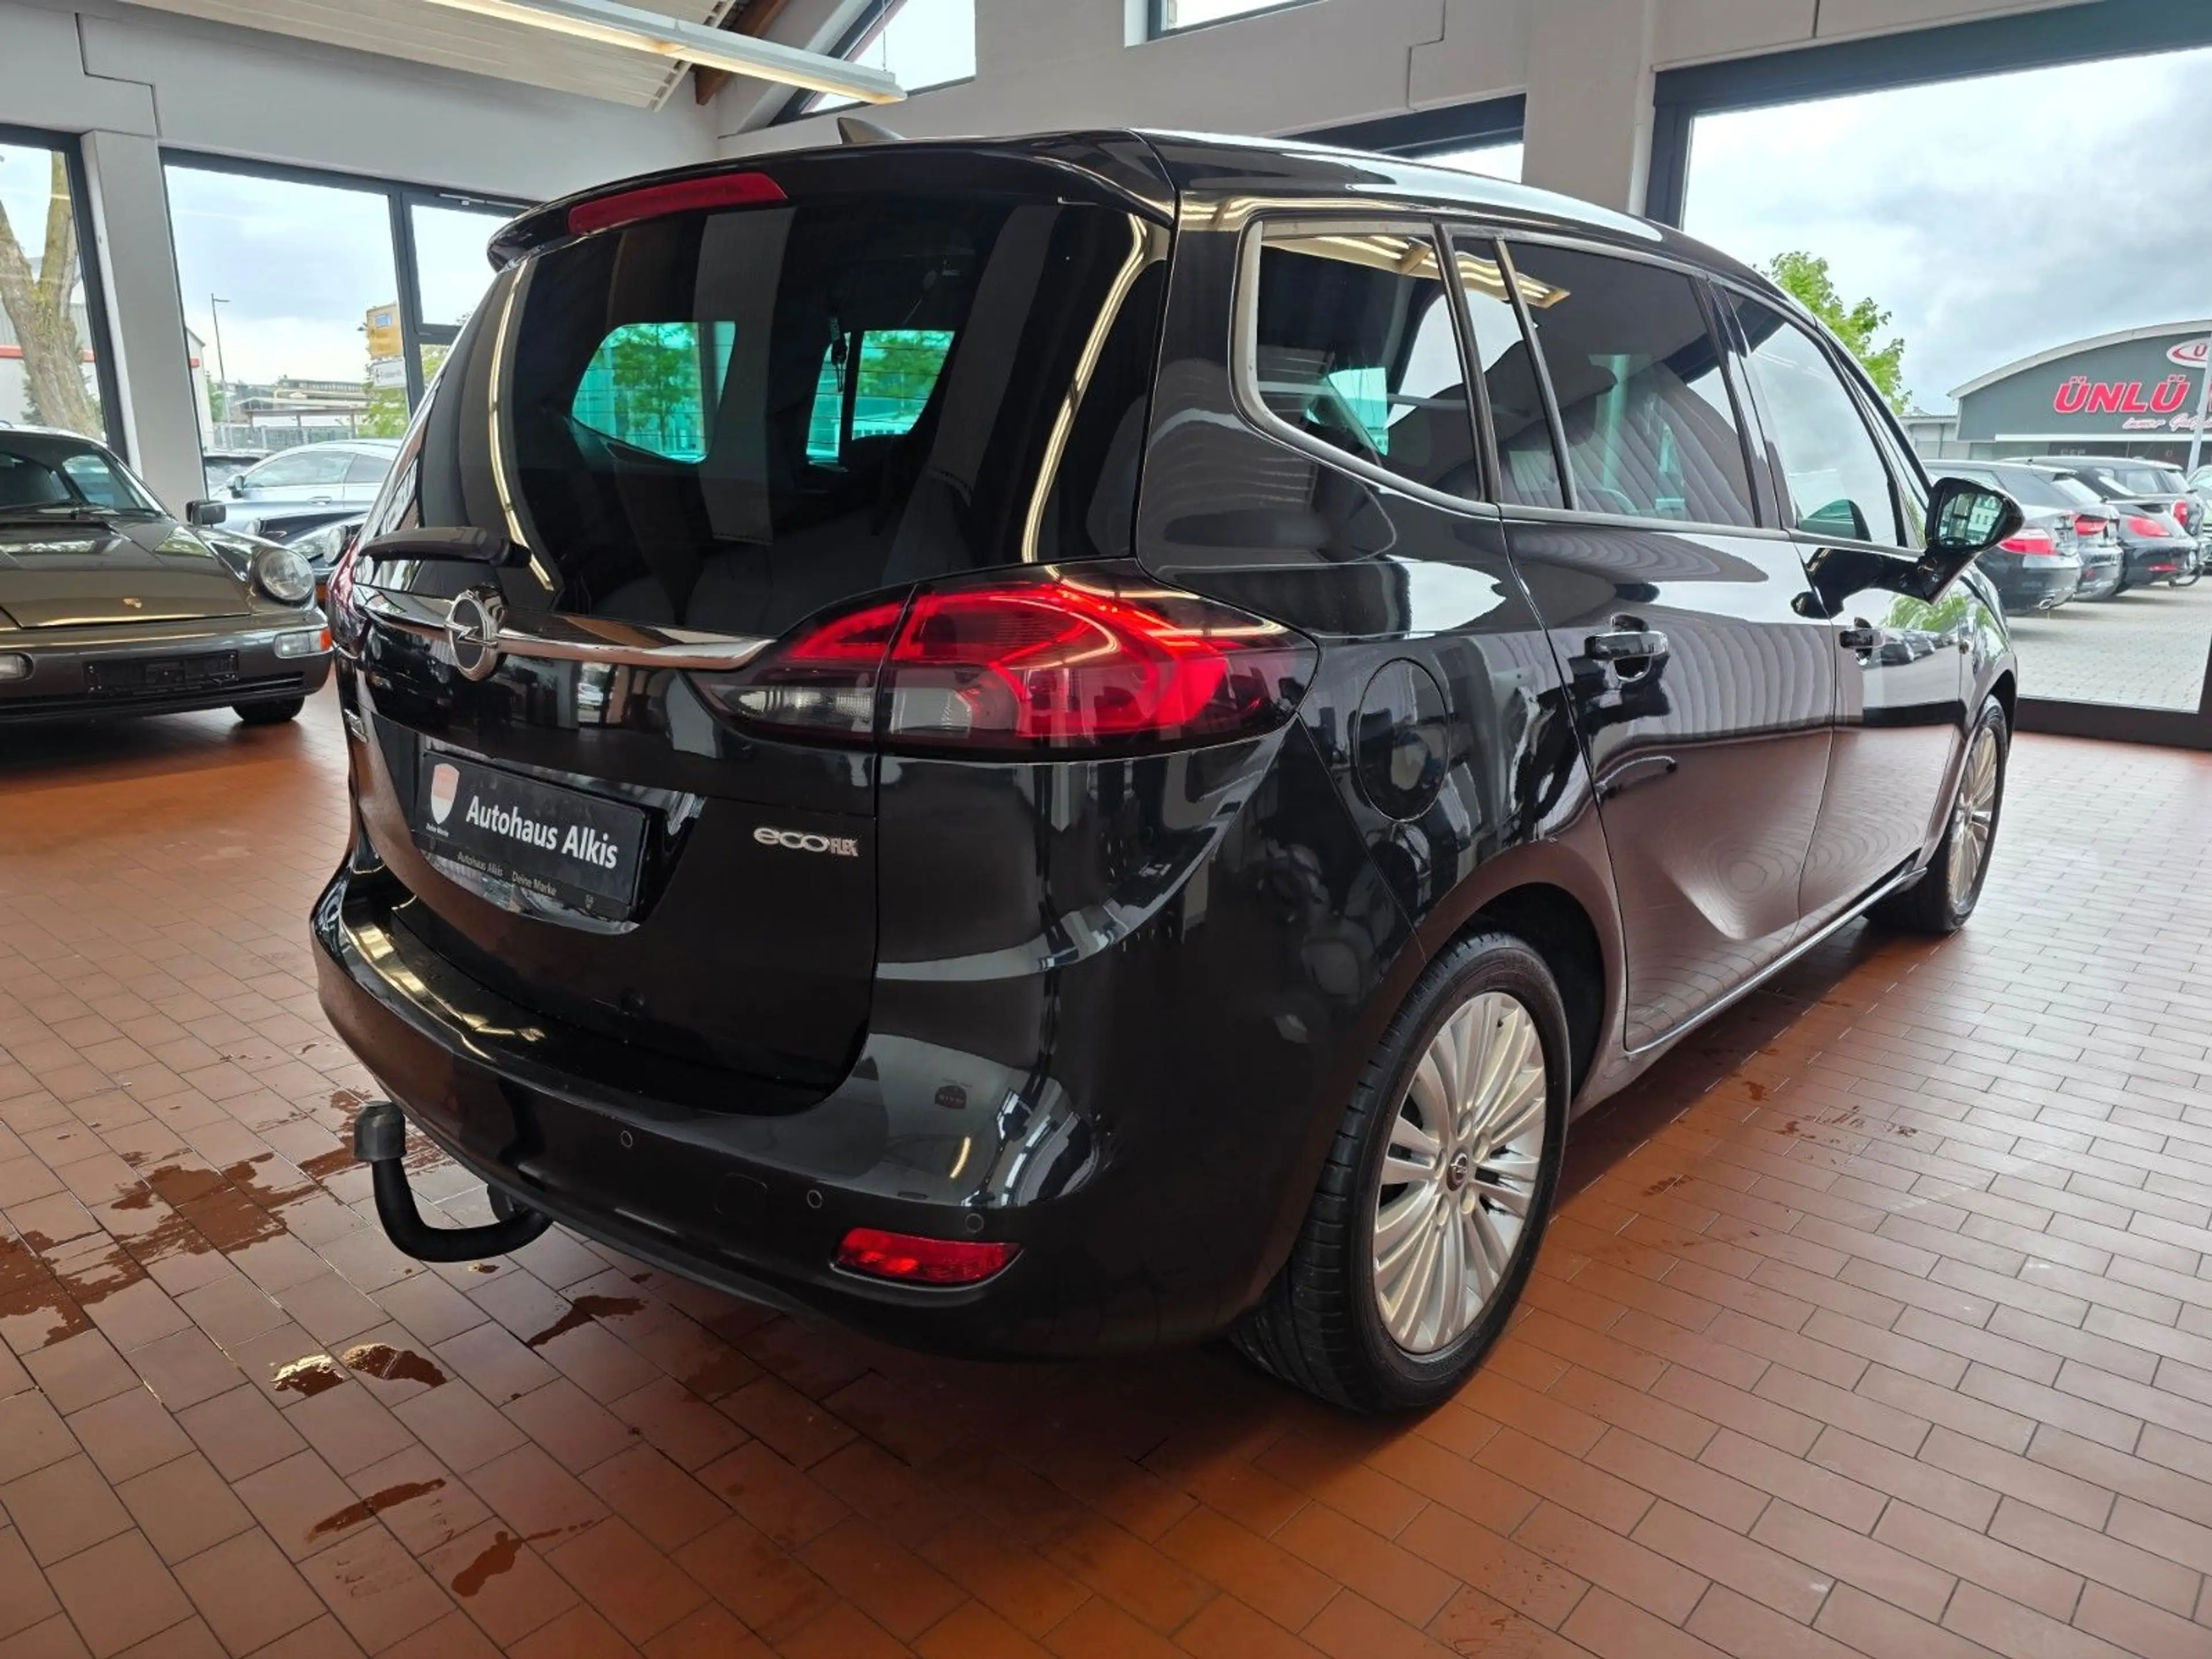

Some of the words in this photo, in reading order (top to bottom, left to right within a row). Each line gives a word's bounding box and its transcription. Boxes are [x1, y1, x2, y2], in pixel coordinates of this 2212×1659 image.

[2053, 374, 2191, 414] ÜNLÜ
[465, 795, 558, 850] Autohaus
[561, 825, 619, 869] Alkis
[457, 851, 486, 870] Autohaus
